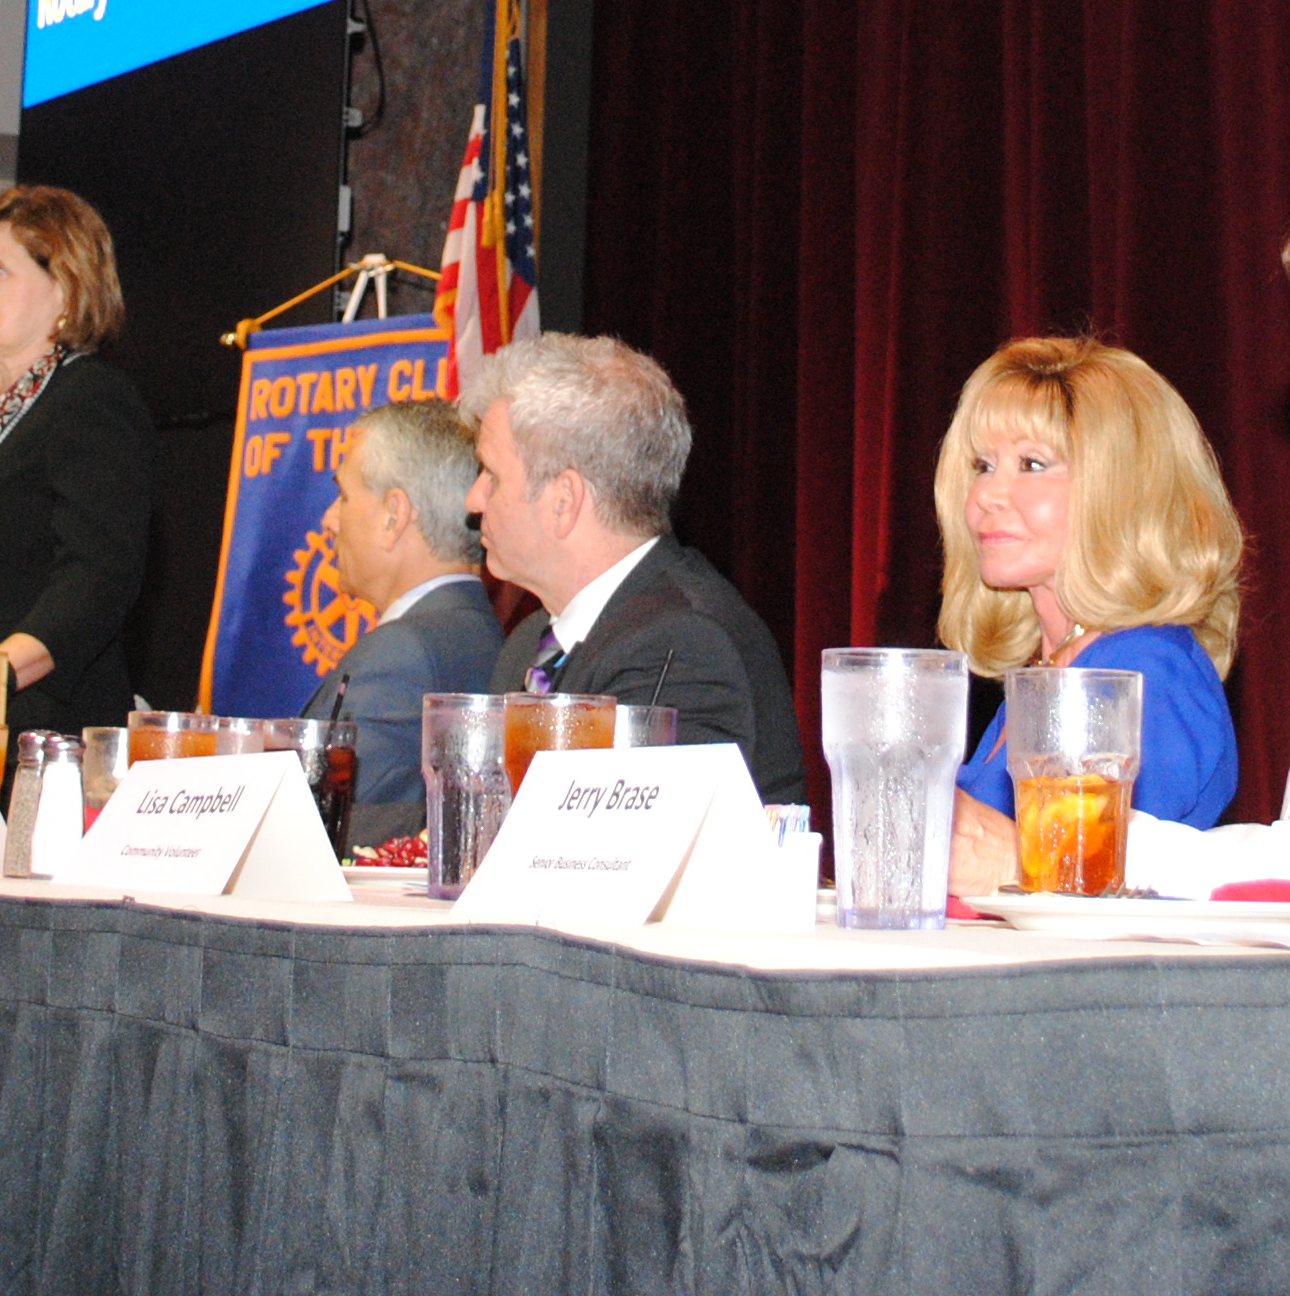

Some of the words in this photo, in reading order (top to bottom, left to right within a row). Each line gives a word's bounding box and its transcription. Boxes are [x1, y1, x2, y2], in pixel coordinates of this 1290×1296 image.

[250, 363, 378, 421] ROTARY
[244, 432, 291, 478] OF
[306, 426, 367, 472] TH
[136, 789, 169, 814] Lisa
[168, 785, 246, 820] Campbell
[558, 779, 608, 819] Jerry
[605, 779, 660, 810] Brase
[120, 844, 164, 859] Community
[164, 845, 202, 858] Volunteer
